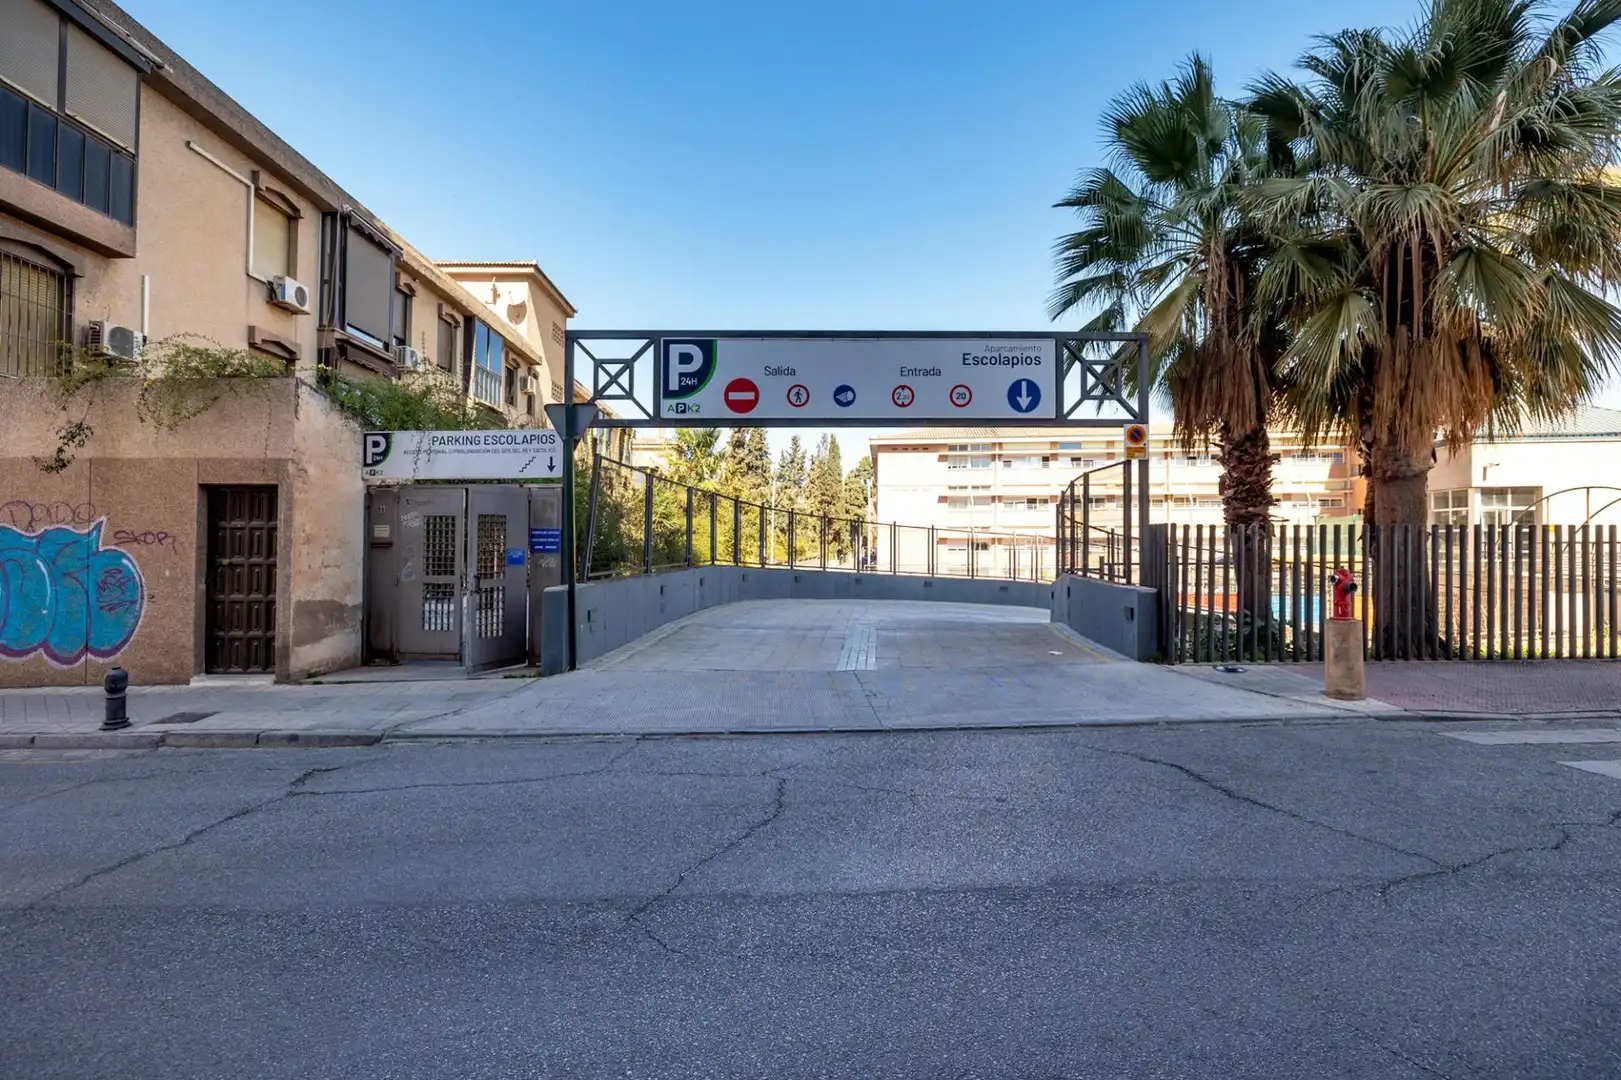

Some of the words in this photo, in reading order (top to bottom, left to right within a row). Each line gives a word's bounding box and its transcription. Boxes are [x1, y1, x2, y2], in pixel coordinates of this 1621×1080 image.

[984, 344, 1042, 353] Aparcamiento
[962, 353, 1042, 368] Escolapios
[669, 343, 704, 391] P
[764, 365, 797, 377] Salida
[900, 366, 942, 377] Entrada
[680, 377, 698, 386] 24H
[955, 392, 967, 401] 20
[431, 435, 481, 446] PARKING
[483, 434, 556, 446] ESCOLAPIOS
[366, 435, 387, 464] P
